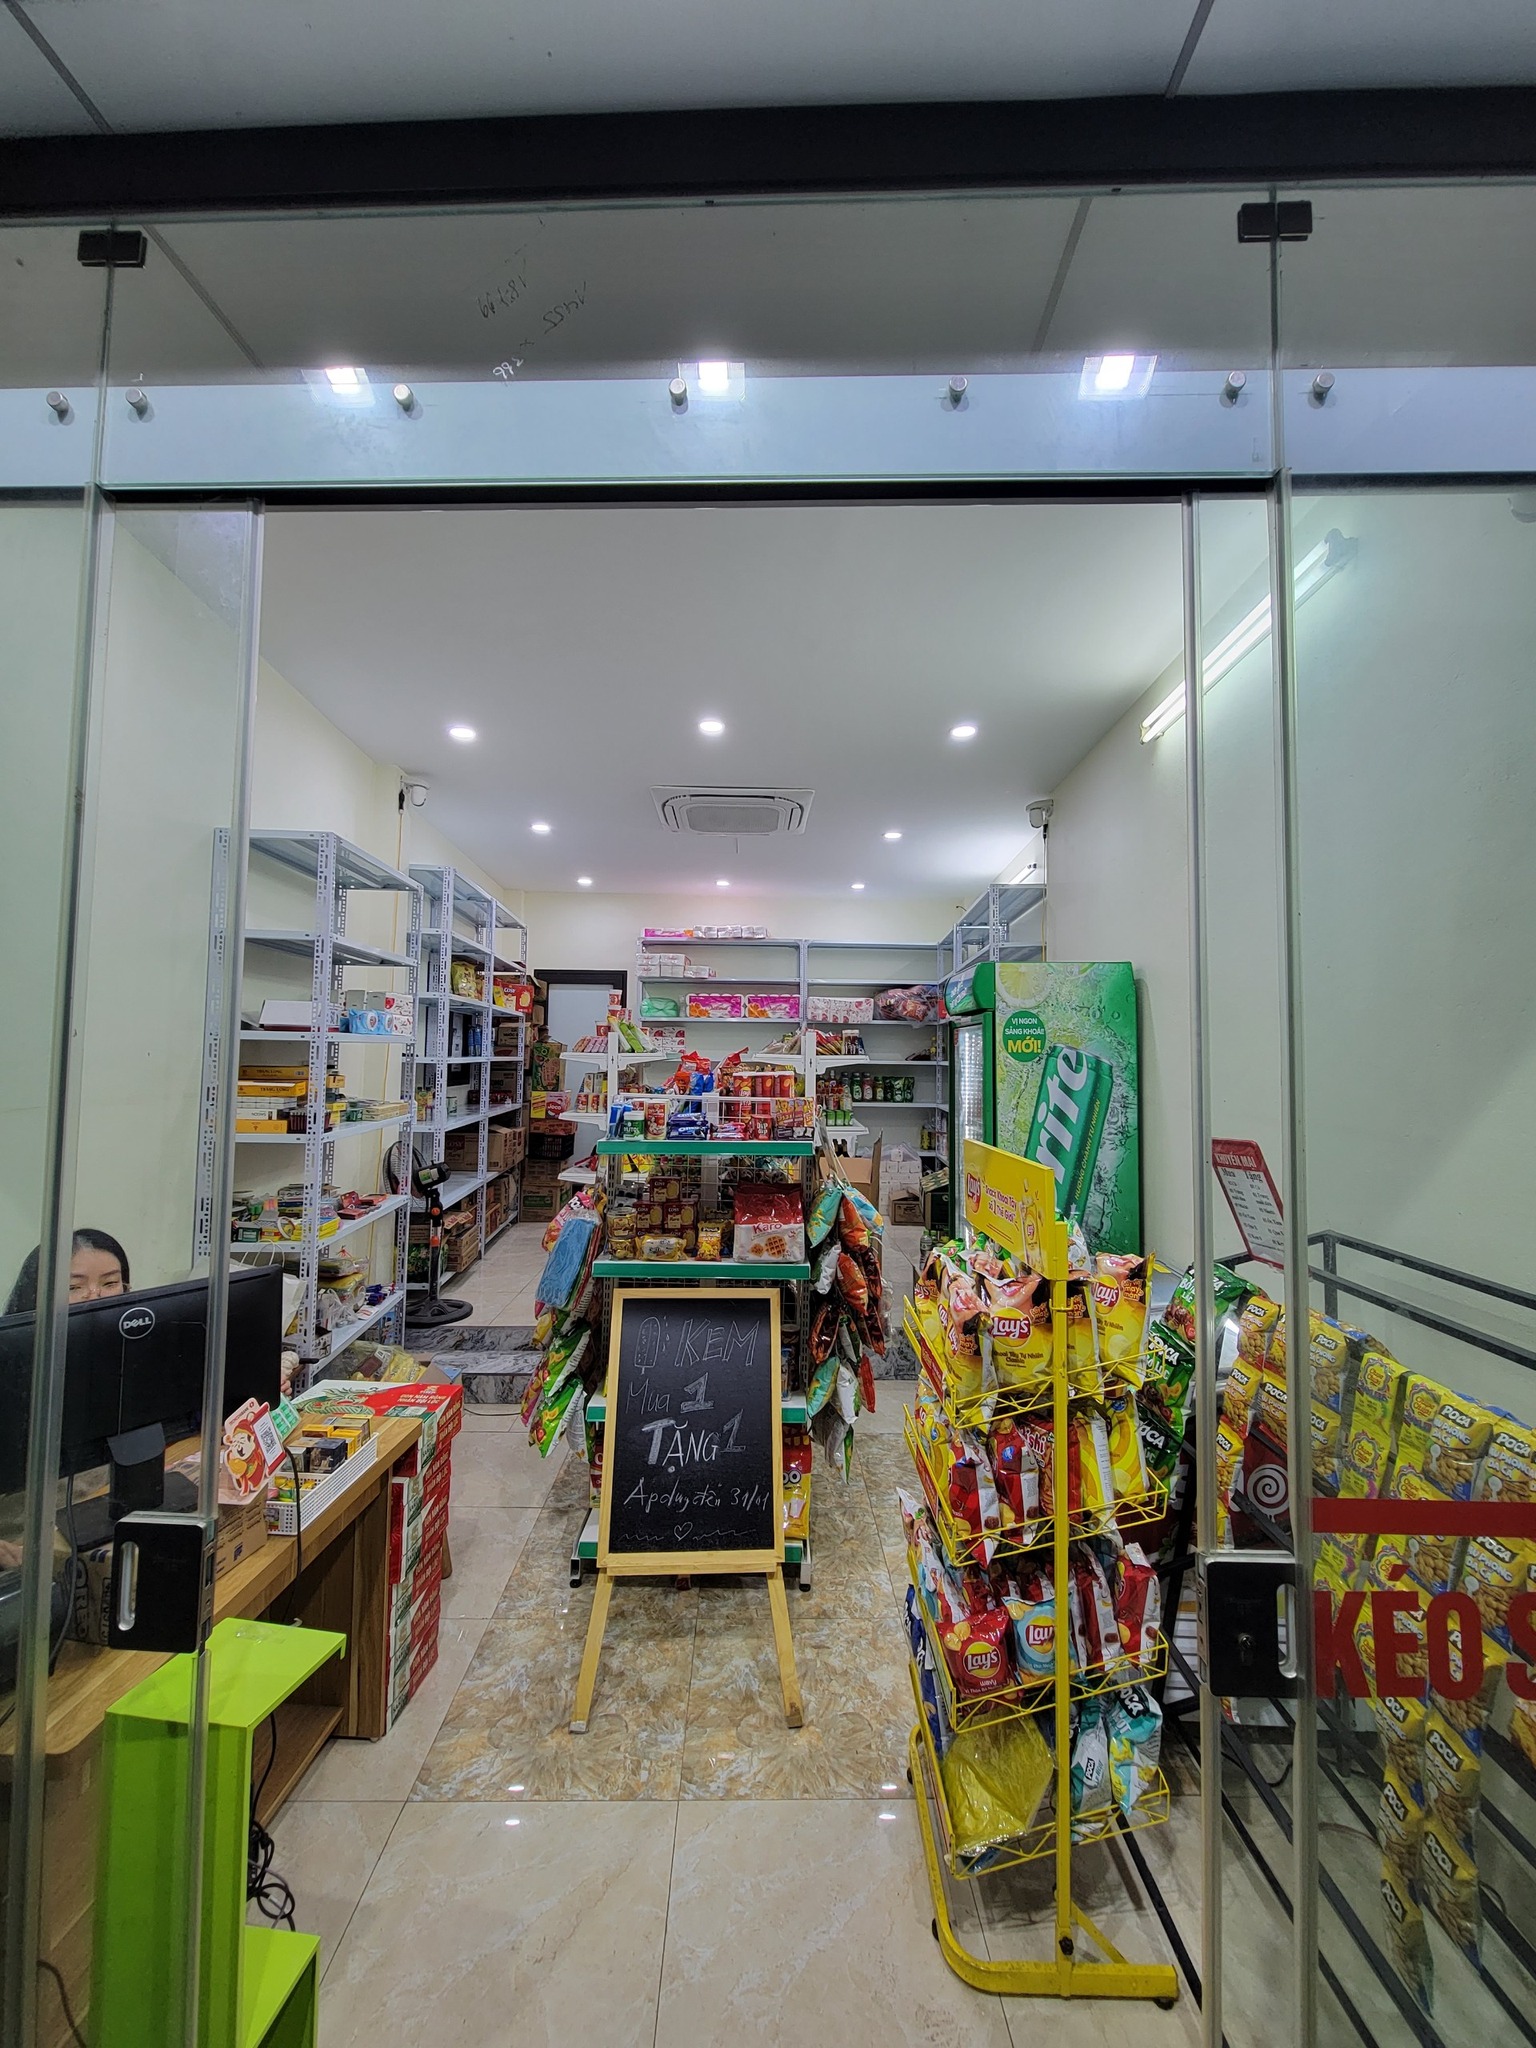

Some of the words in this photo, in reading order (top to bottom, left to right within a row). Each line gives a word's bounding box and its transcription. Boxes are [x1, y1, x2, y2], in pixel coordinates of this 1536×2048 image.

[1008, 1036, 1042, 1053] MỚI!
[1035, 1047, 1089, 1184] rite
[753, 1223, 782, 1234] Karo
[1246, 1305, 1265, 1317] POCA
[123, 1317, 152, 1330] DELL
[991, 1317, 1030, 1339] Lay's
[674, 1318, 760, 1367] KEM
[1315, 1334, 1337, 1350] POCA
[1231, 1369, 1248, 1385] POCA
[626, 1378, 670, 1414] Mua
[680, 1372, 715, 1414] 1
[1264, 1384, 1288, 1402] POCA
[1441, 1405, 1471, 1428] POCA
[641, 1416, 721, 1473] TẶNG
[720, 1408, 746, 1453] 1
[1216, 1434, 1231, 1451] POCA
[1496, 1433, 1531, 1457] POCA
[1029, 1626, 1055, 1645] Lay
[1314, 1563, 1483, 1700] KÉO
[967, 1650, 998, 1671] Lay's
[1429, 1731, 1460, 1771] POCA
[1086, 1758, 1095, 1780] POCA
[1384, 1786, 1406, 1821] POCA
[1426, 1834, 1453, 1877] POCA
